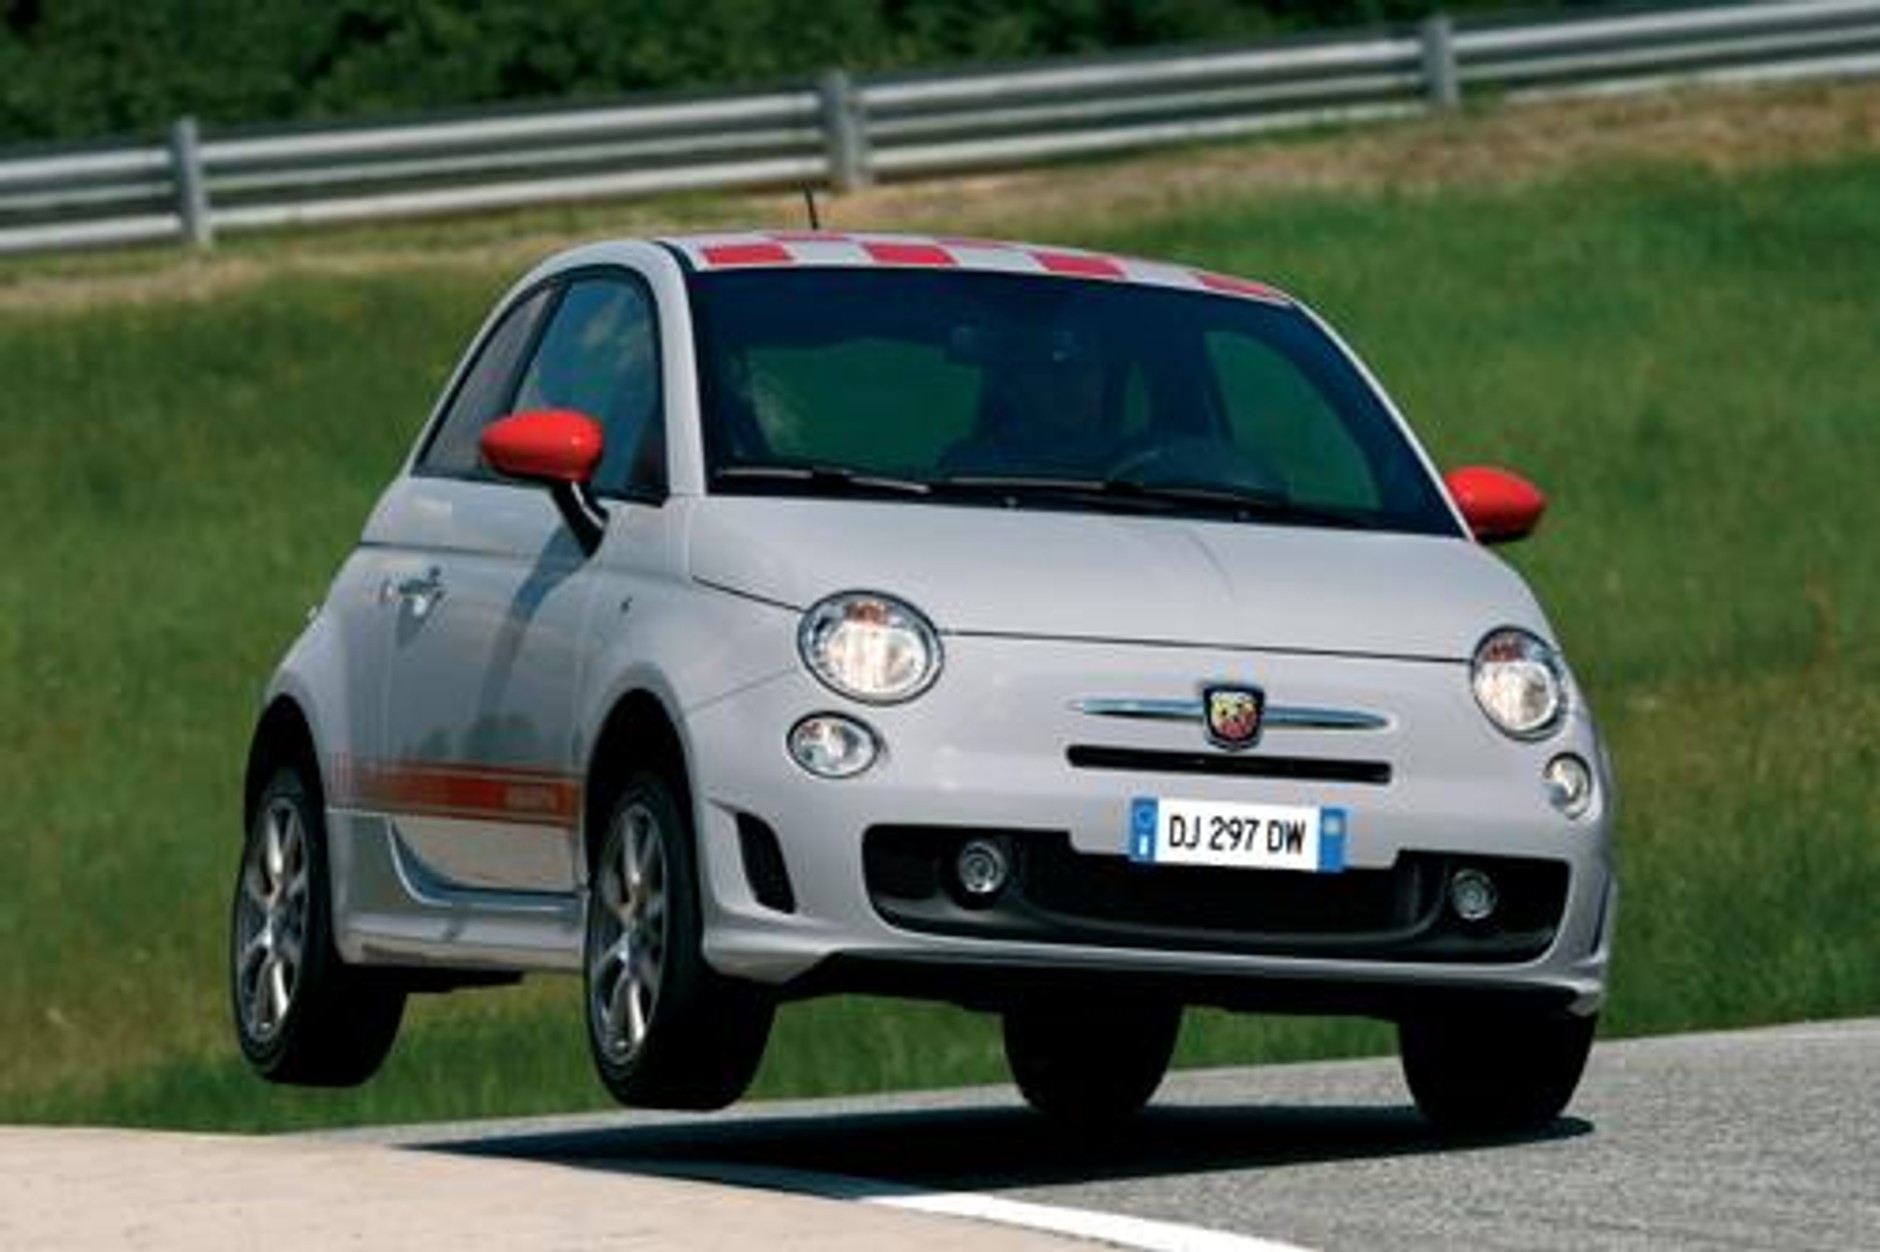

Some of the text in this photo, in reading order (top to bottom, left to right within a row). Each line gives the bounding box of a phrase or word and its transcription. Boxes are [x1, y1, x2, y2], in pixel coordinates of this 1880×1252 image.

[1169, 815, 1306, 854] DJ 297 DW
